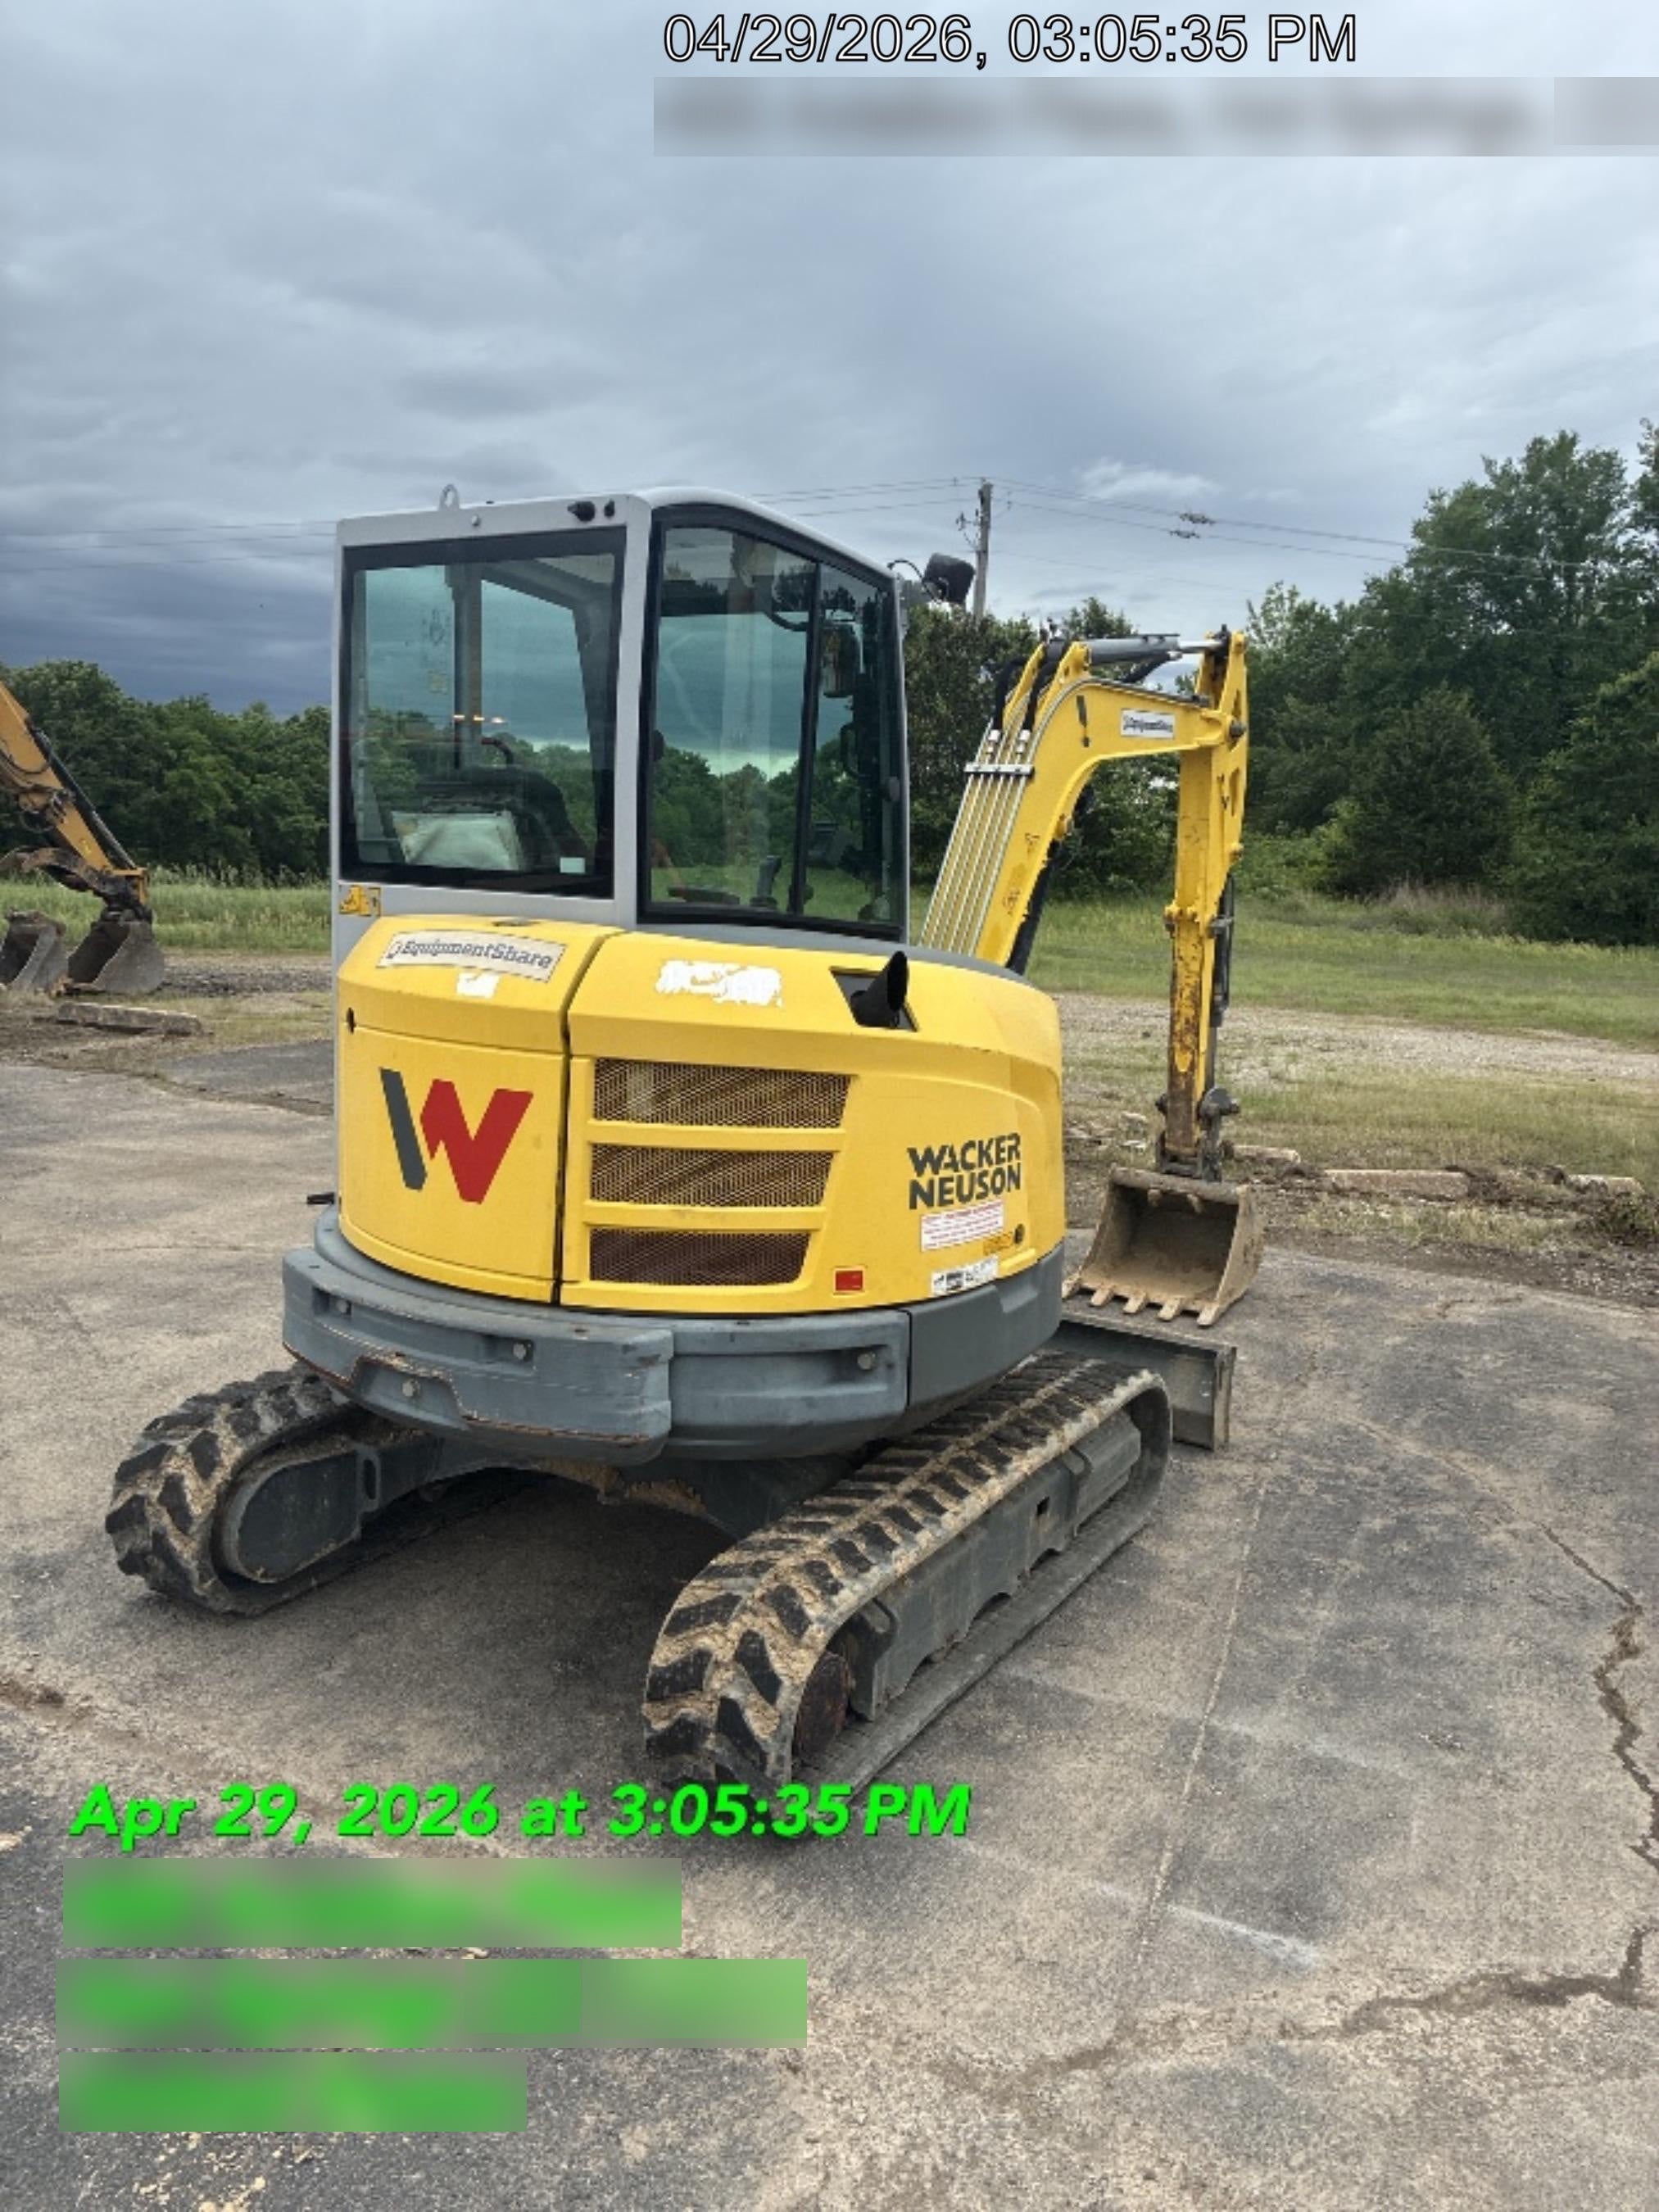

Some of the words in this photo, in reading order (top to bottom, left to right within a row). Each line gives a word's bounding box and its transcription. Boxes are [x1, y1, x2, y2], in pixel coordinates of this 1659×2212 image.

[402, 939, 553, 968] EquipmentShare
[907, 1132, 1022, 1177] WACKER
[909, 1163, 1022, 1210] NEUSON
